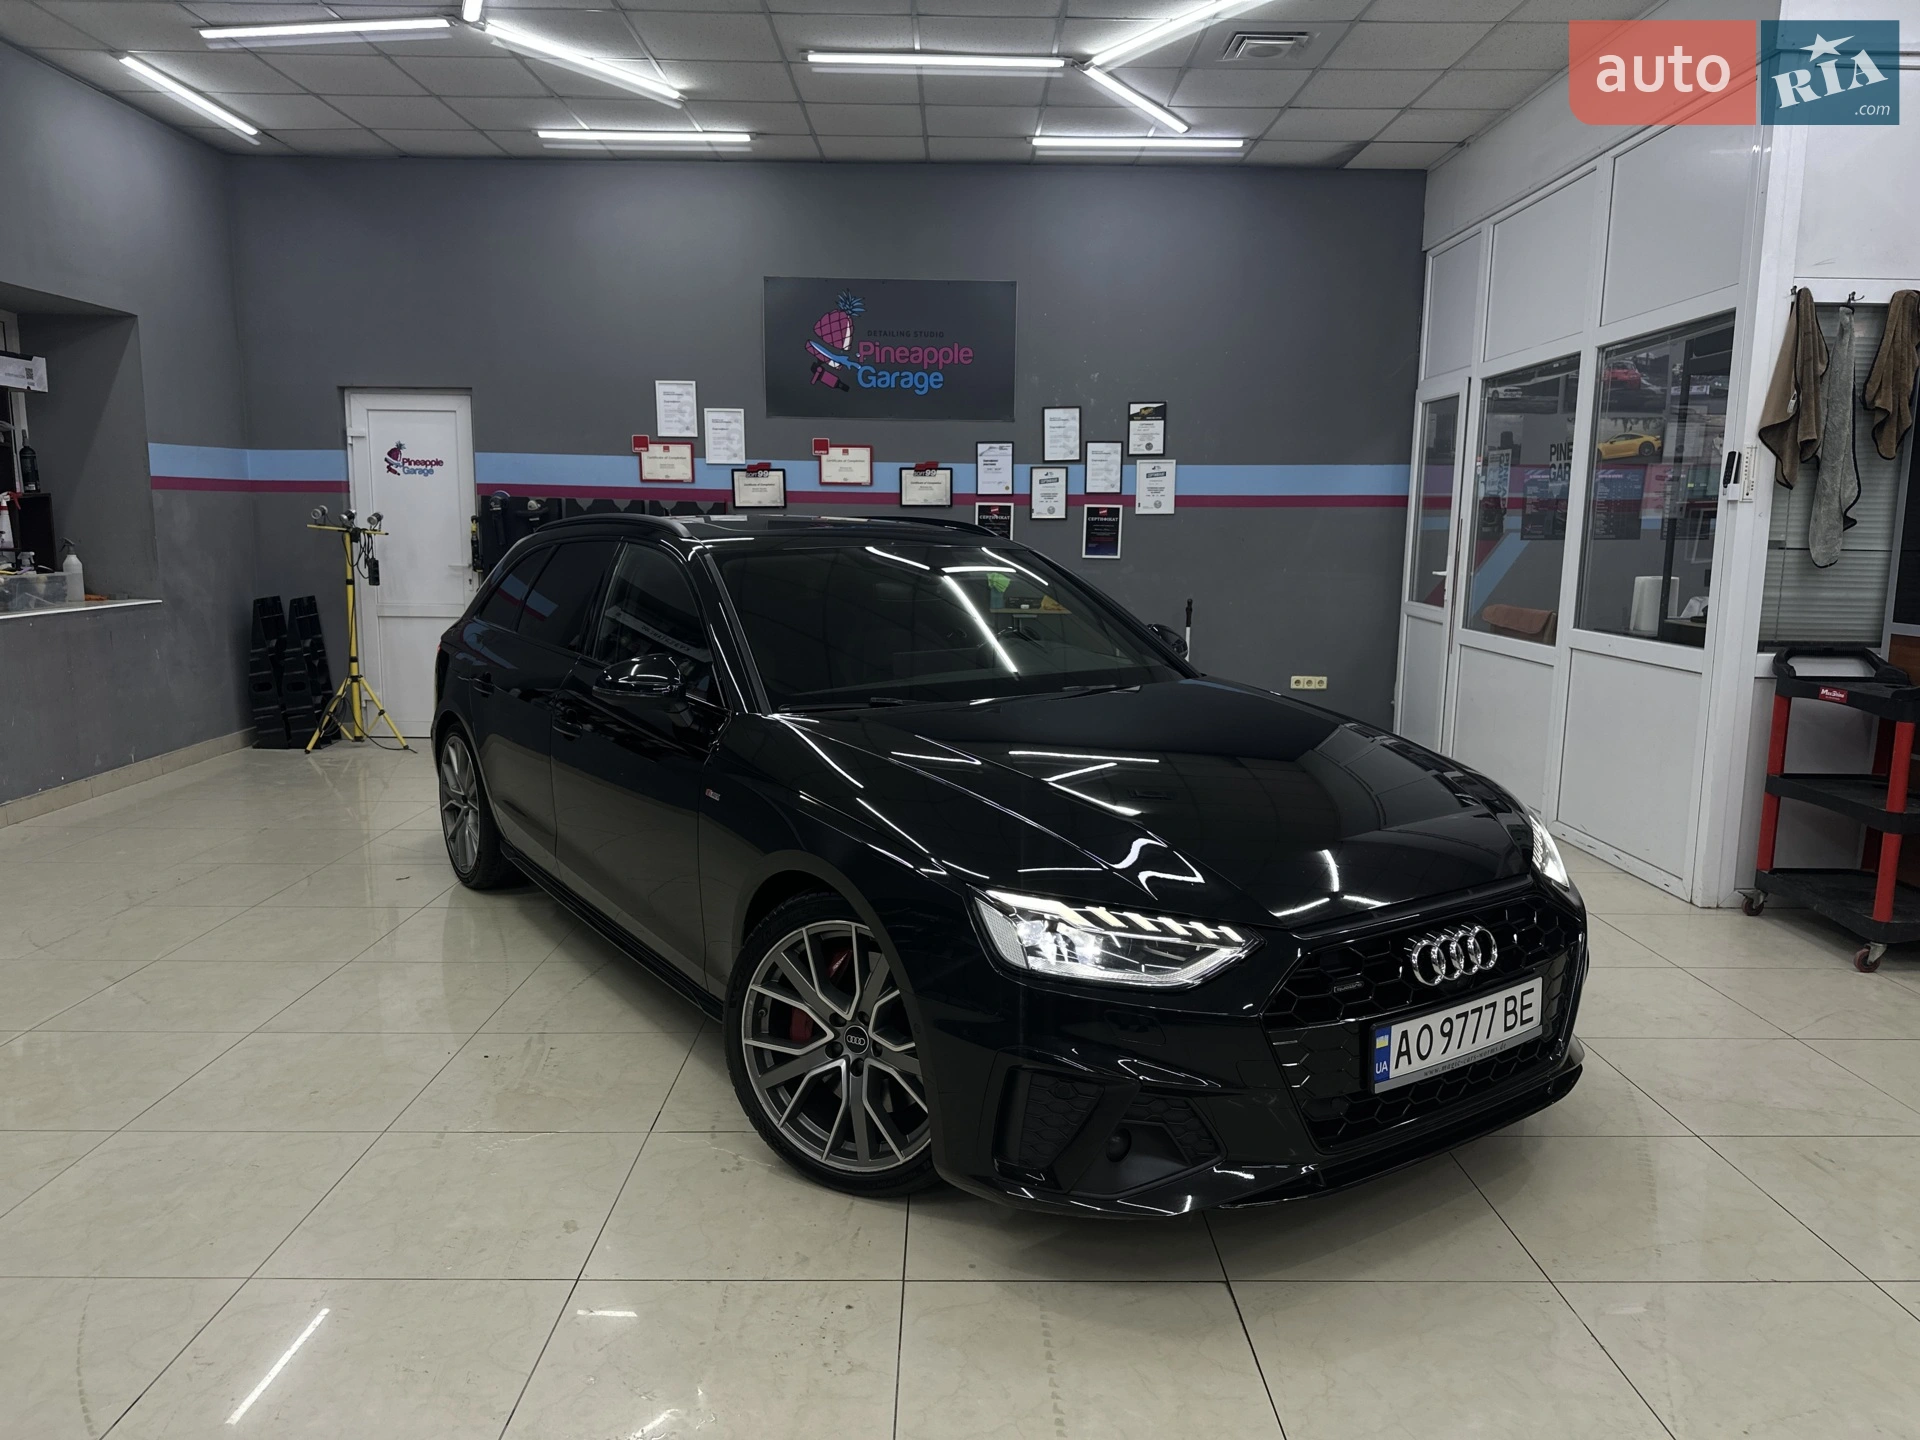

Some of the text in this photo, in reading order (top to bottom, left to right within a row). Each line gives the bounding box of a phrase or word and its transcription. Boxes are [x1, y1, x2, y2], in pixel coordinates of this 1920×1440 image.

[867, 329, 945, 338] DETAILING STUDIO
[858, 341, 974, 370] Pineapple
[857, 365, 944, 396] Garage
[402, 457, 444, 468] Pineapple
[402, 466, 435, 477] Garage
[1394, 987, 1535, 1070] AO 9777 BE
[1375, 1061, 1389, 1074] UA
[1423, 1042, 1507, 1077] www.magic-cars-worms.de
